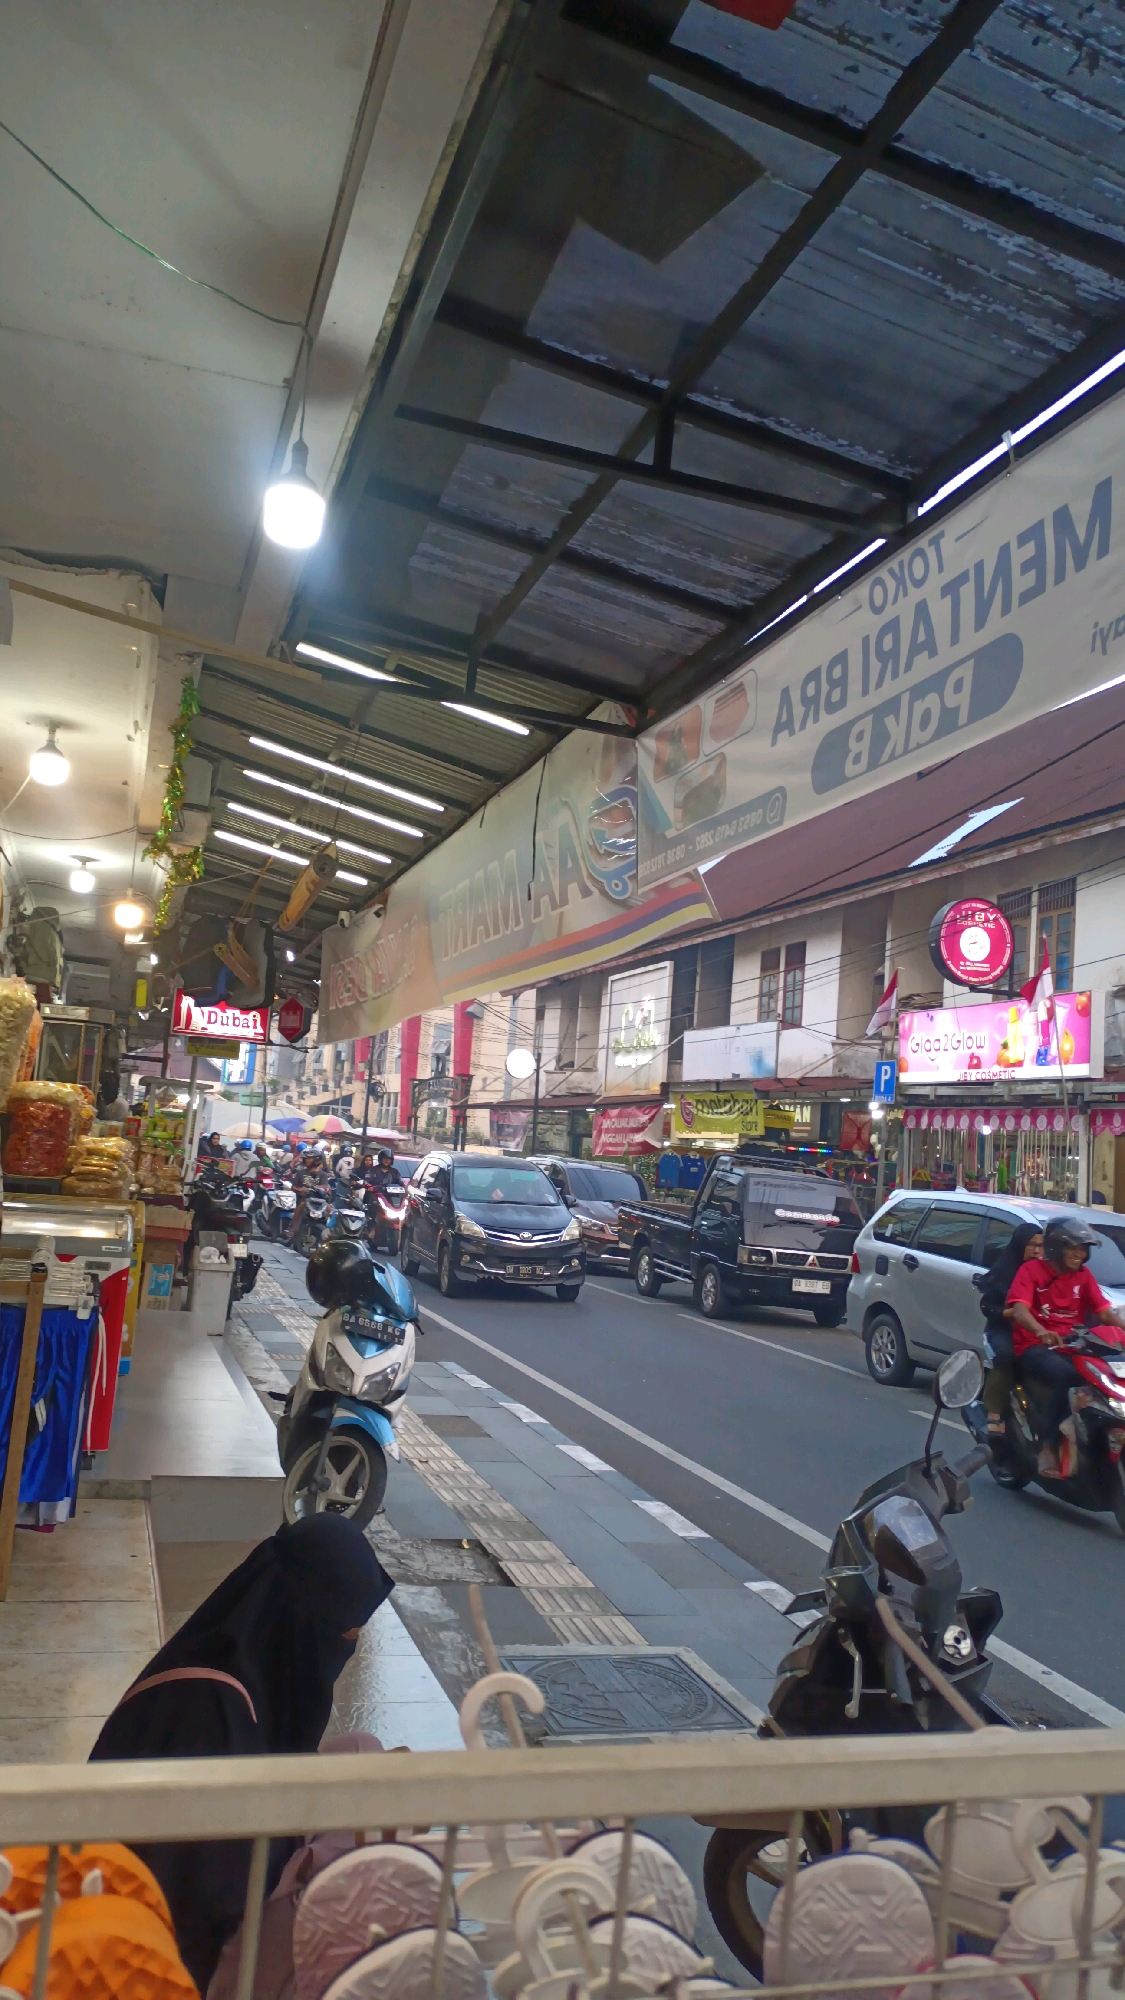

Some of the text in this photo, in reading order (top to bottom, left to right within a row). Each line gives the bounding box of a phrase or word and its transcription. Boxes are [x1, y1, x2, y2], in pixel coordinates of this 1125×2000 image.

[206, 1010, 260, 1030] Dubai
[880, 1065, 891, 1093] P
[975, 1069, 1016, 1082] COSMETIC
[694, 1093, 759, 1117] matahari
[741, 1120, 759, 1131] store
[342, 1313, 356, 1323] BA
